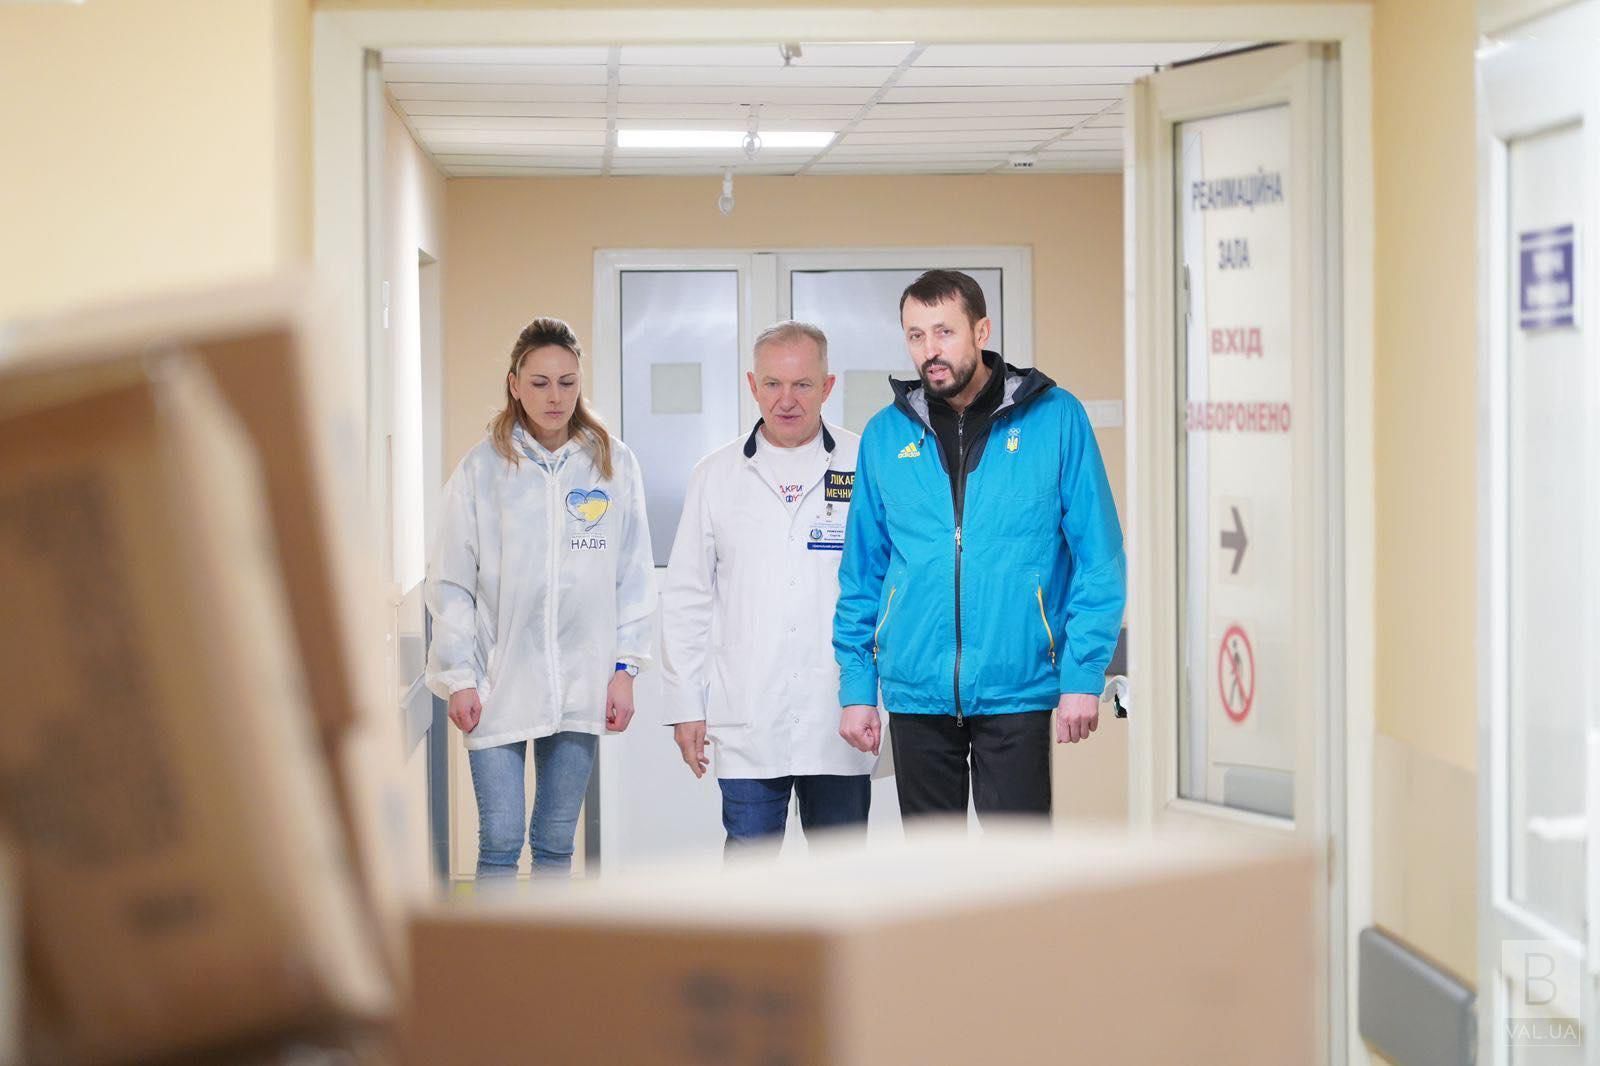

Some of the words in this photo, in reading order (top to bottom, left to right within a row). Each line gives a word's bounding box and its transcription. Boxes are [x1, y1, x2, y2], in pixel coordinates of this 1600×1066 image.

[1191, 166, 1284, 212] РЕАНІМАЦІЙНА
[1217, 238, 1250, 269] ЗАЛА
[1211, 327, 1264, 358] ВХІД
[1185, 402, 1292, 433] ЗАБОРОНЕНО
[571, 538, 606, 550] НАДІЯ
